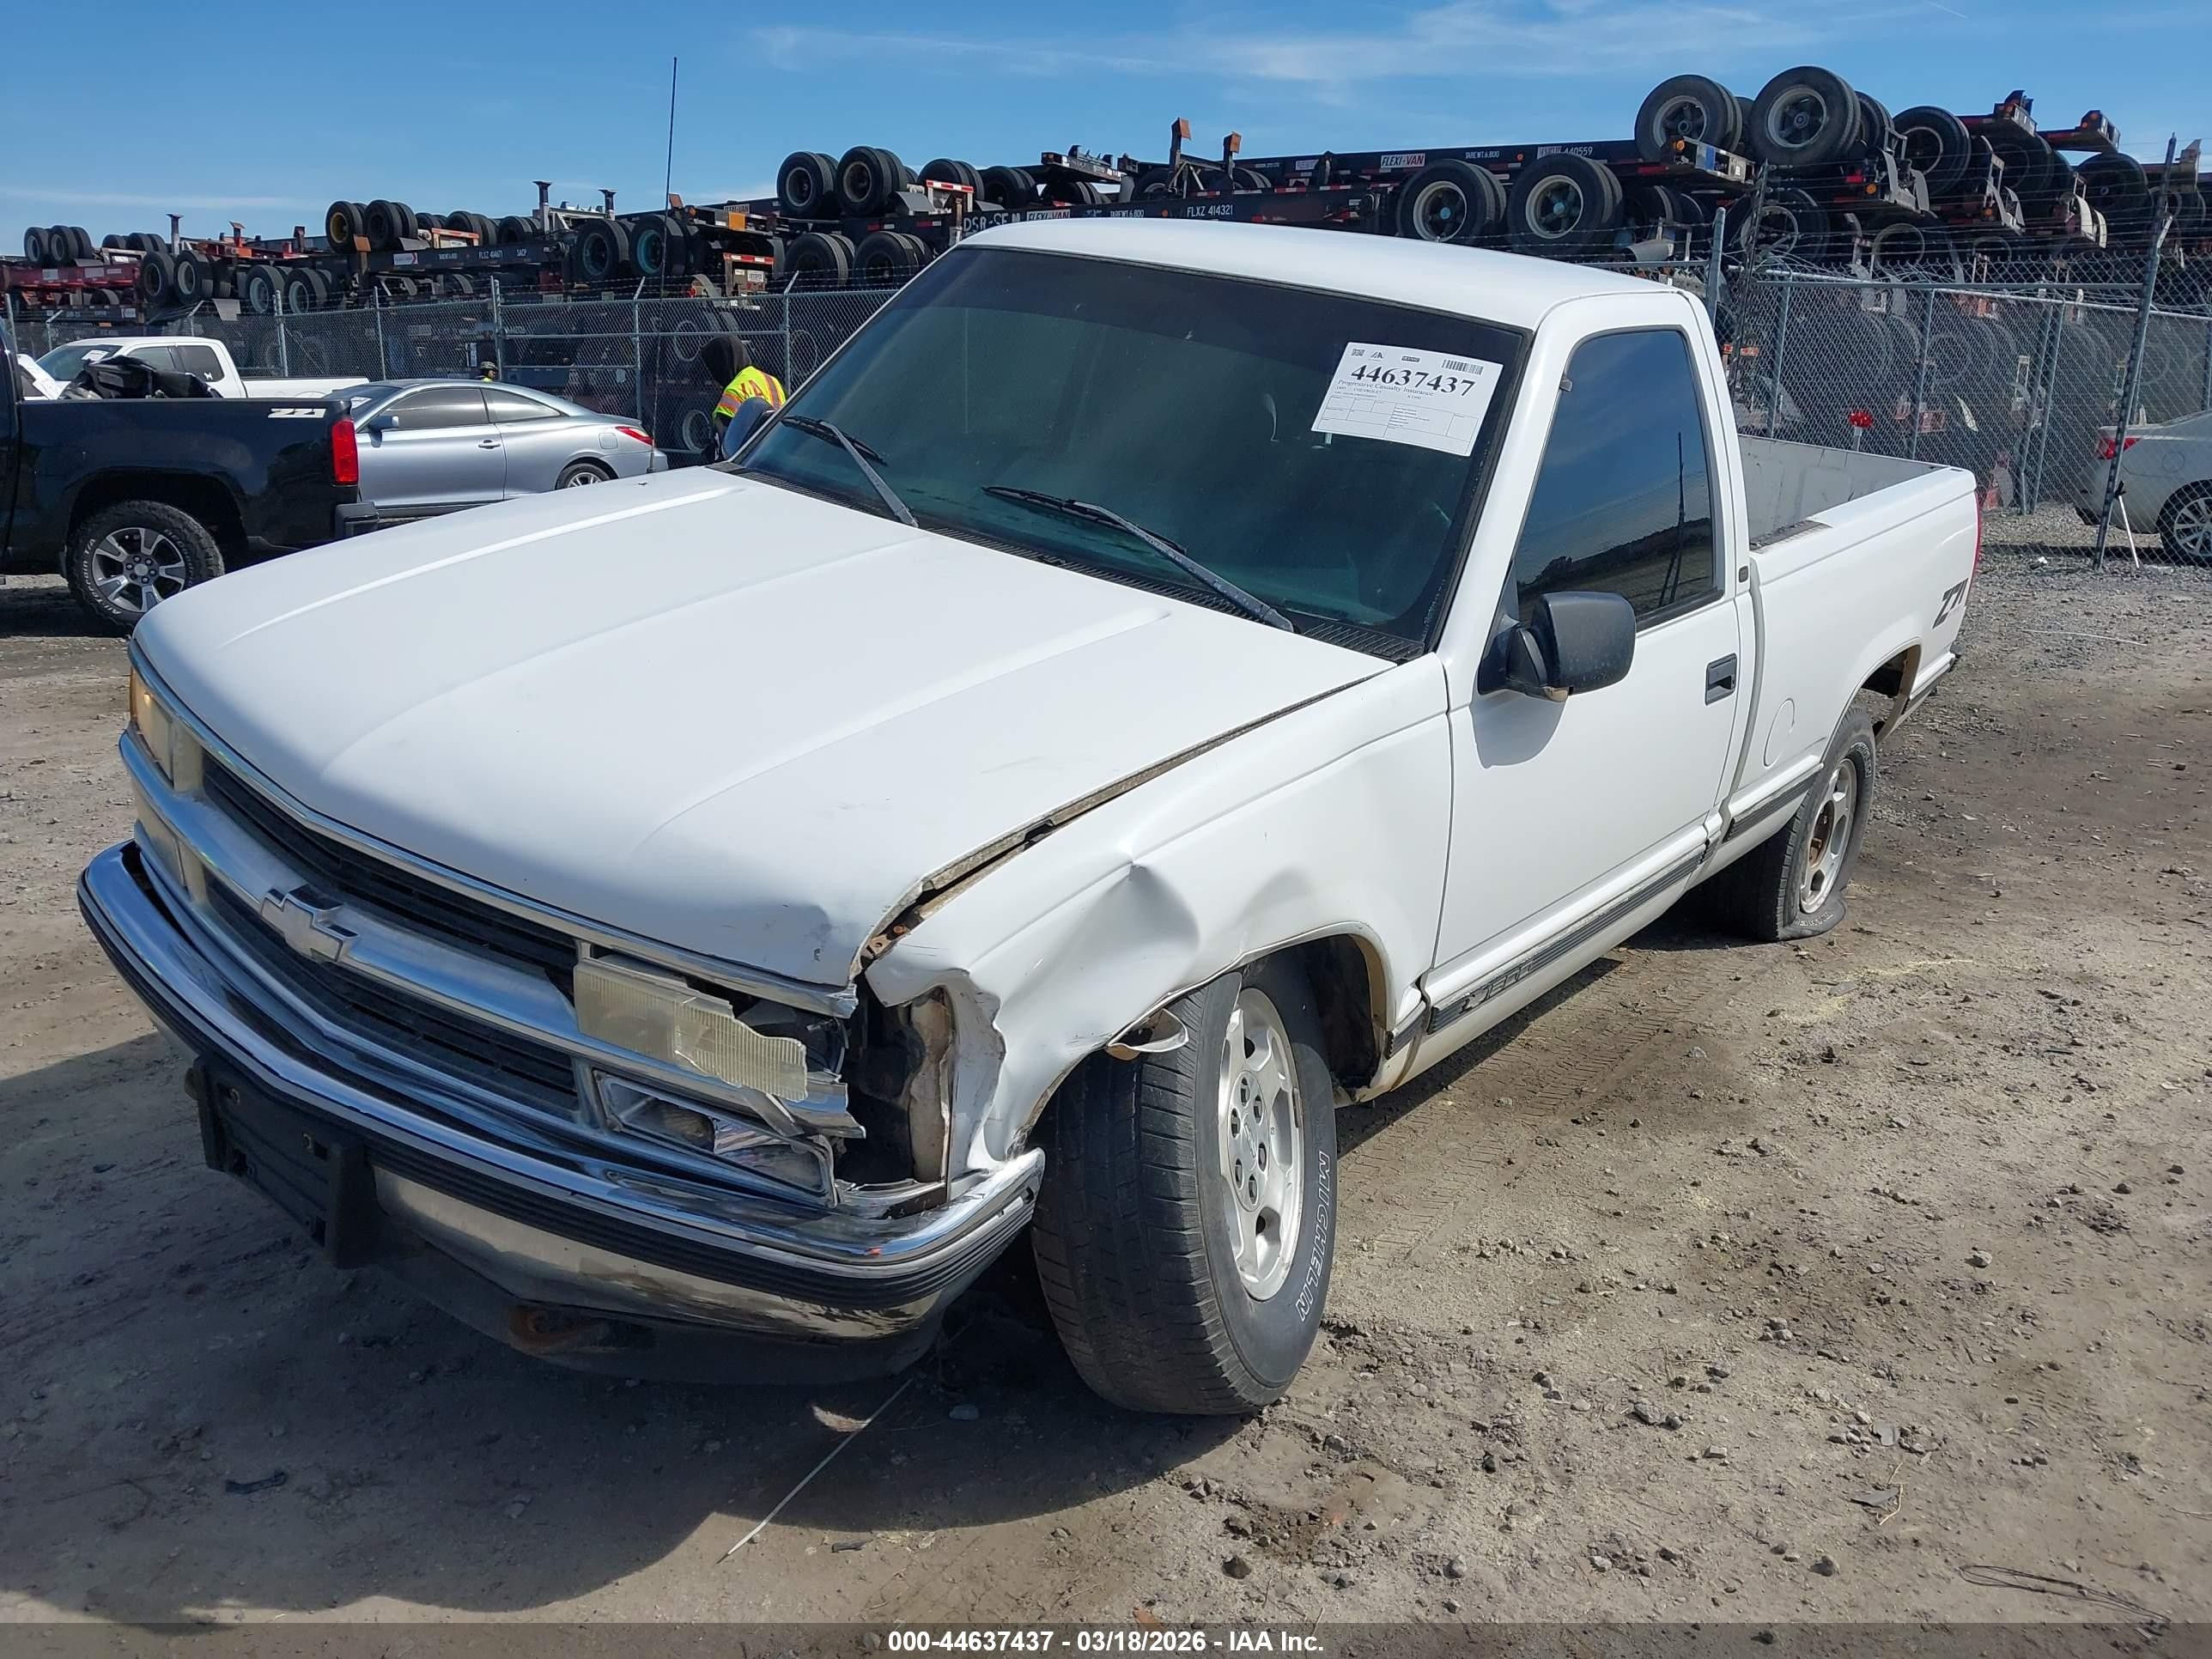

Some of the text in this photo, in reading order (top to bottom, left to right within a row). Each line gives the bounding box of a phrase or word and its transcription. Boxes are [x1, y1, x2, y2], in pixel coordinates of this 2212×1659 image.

[1382, 154, 1424, 167] FLEXI-VAN
[1187, 204, 1233, 217] FLXZ 414321
[1351, 364, 1477, 397] 44637437
[1375, 383, 1401, 392] Casualty
[1403, 386, 1435, 398] Insurance
[1295, 1150, 1331, 1323] MICHELIN
